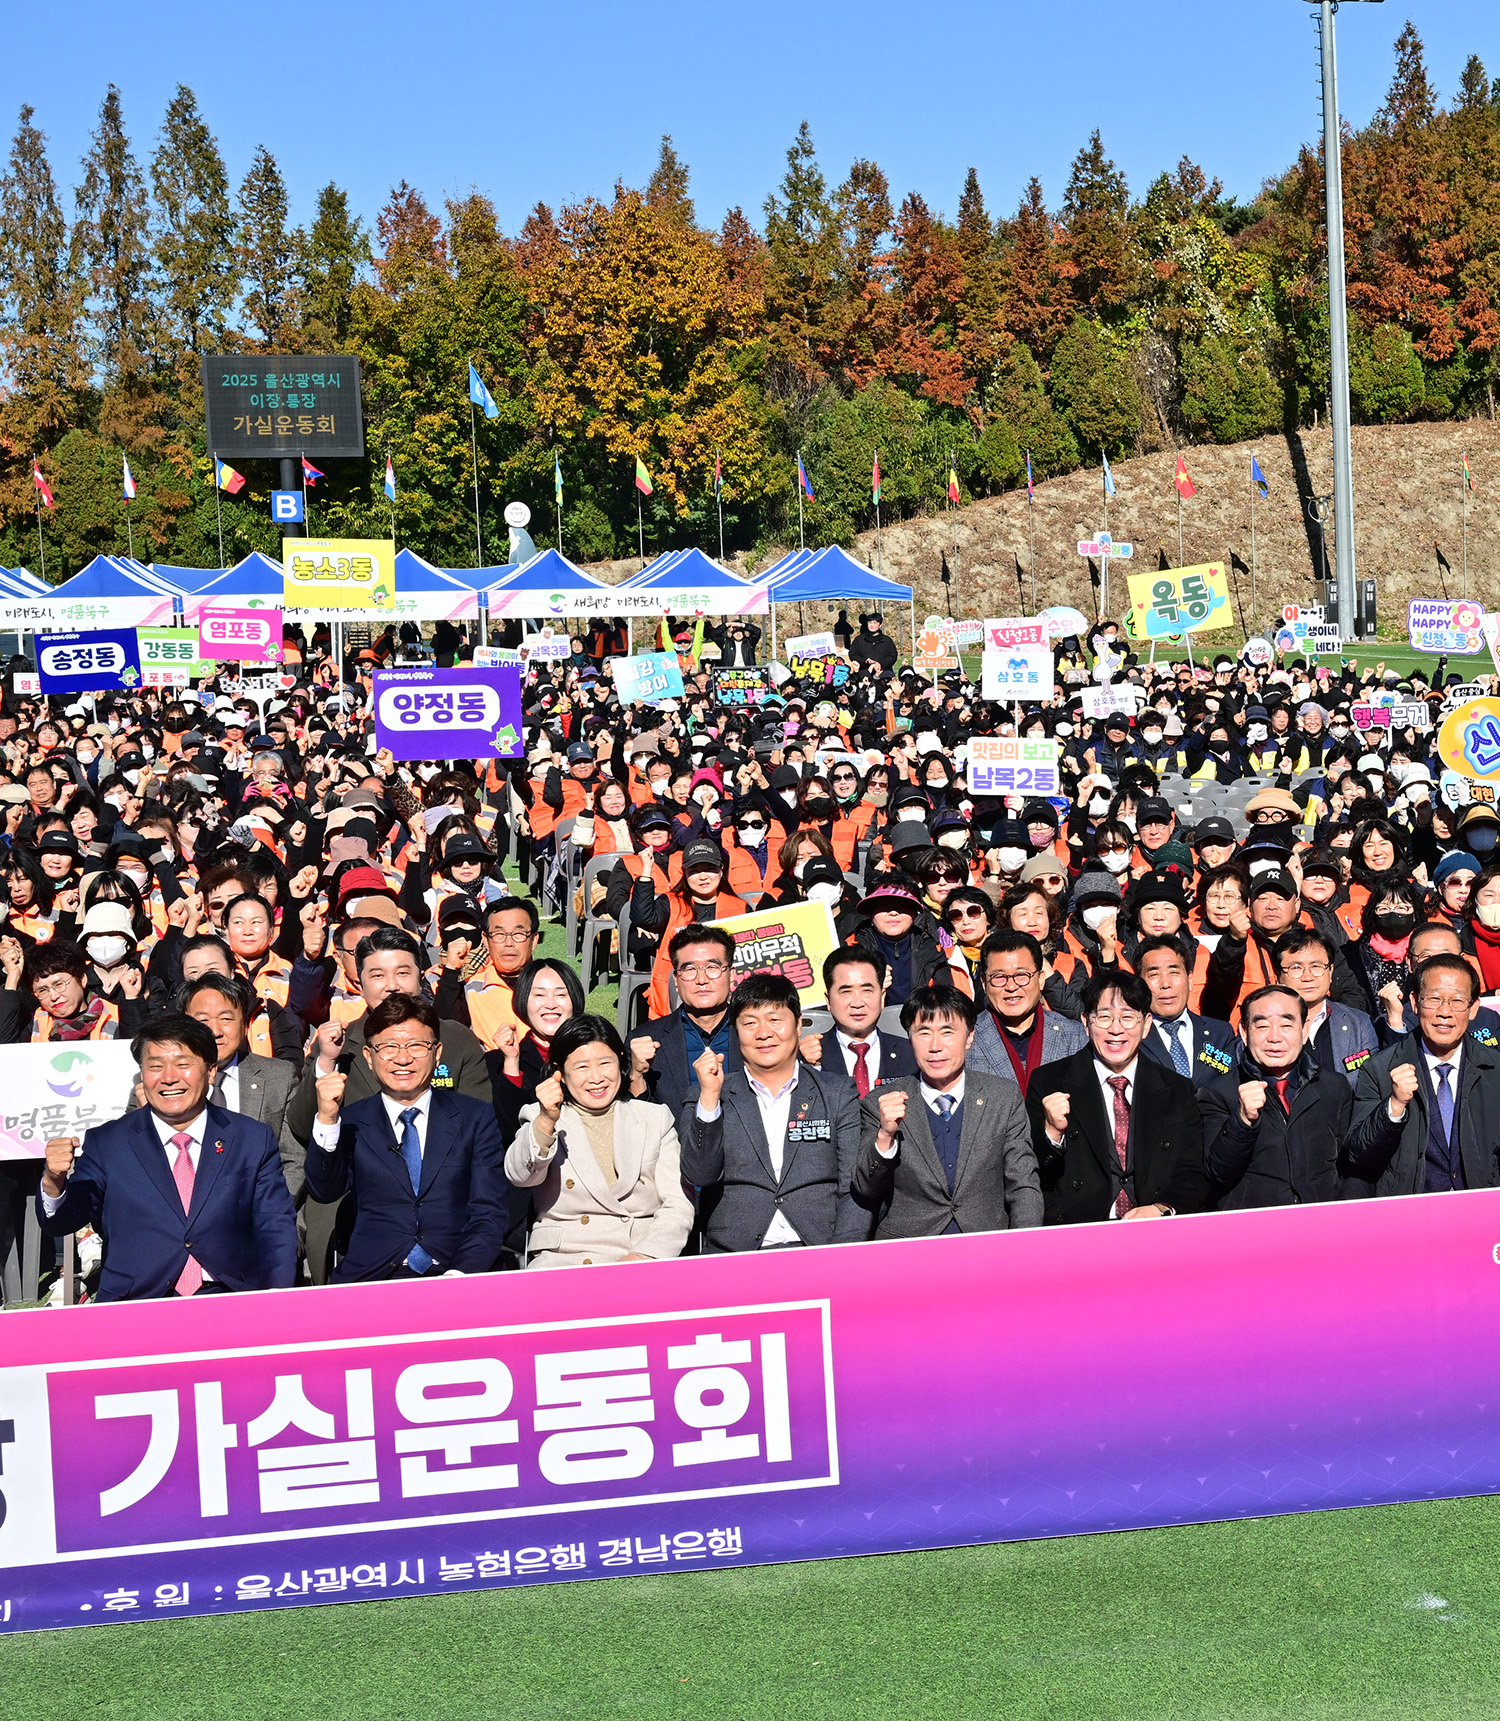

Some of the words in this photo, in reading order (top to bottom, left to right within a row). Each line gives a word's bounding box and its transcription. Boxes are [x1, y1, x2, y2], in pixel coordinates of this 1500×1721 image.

[221, 374, 258, 386] 2025
[264, 373, 341, 389] 울산광역시
[250, 393, 316, 408] 이장.통장
[233, 414, 336, 436] 가실운동회
[276, 495, 298, 518] B
[292, 556, 373, 581] 농소3동
[574, 595, 611, 609] 새희망
[667, 594, 711, 607] 명품북구
[1152, 574, 1210, 623] 옥동
[61, 604, 110, 619] 명품북구
[1413, 604, 1452, 616] HAPPY
[210, 621, 262, 640] 염포동
[1412, 618, 1451, 630] HAPPY
[996, 628, 1038, 644] 신정1동
[1422, 631, 1468, 647] 신정2동
[52, 647, 116, 671] 송정동
[144, 642, 194, 660] 강동동
[637, 675, 669, 696] 방어
[997, 671, 1039, 683] 삼호동
[393, 692, 486, 724] 양정동
[973, 742, 1019, 761] 맛집의
[1023, 743, 1054, 761] 보고
[972, 767, 1055, 791] 남목2동
[788, 1126, 831, 1142] 공진혁
[94, 1332, 794, 1519] 가실운동회
[235, 1558, 425, 1601] 울산광역시
[438, 1542, 587, 1582] 농협은행
[598, 1526, 744, 1567] 경남은행
